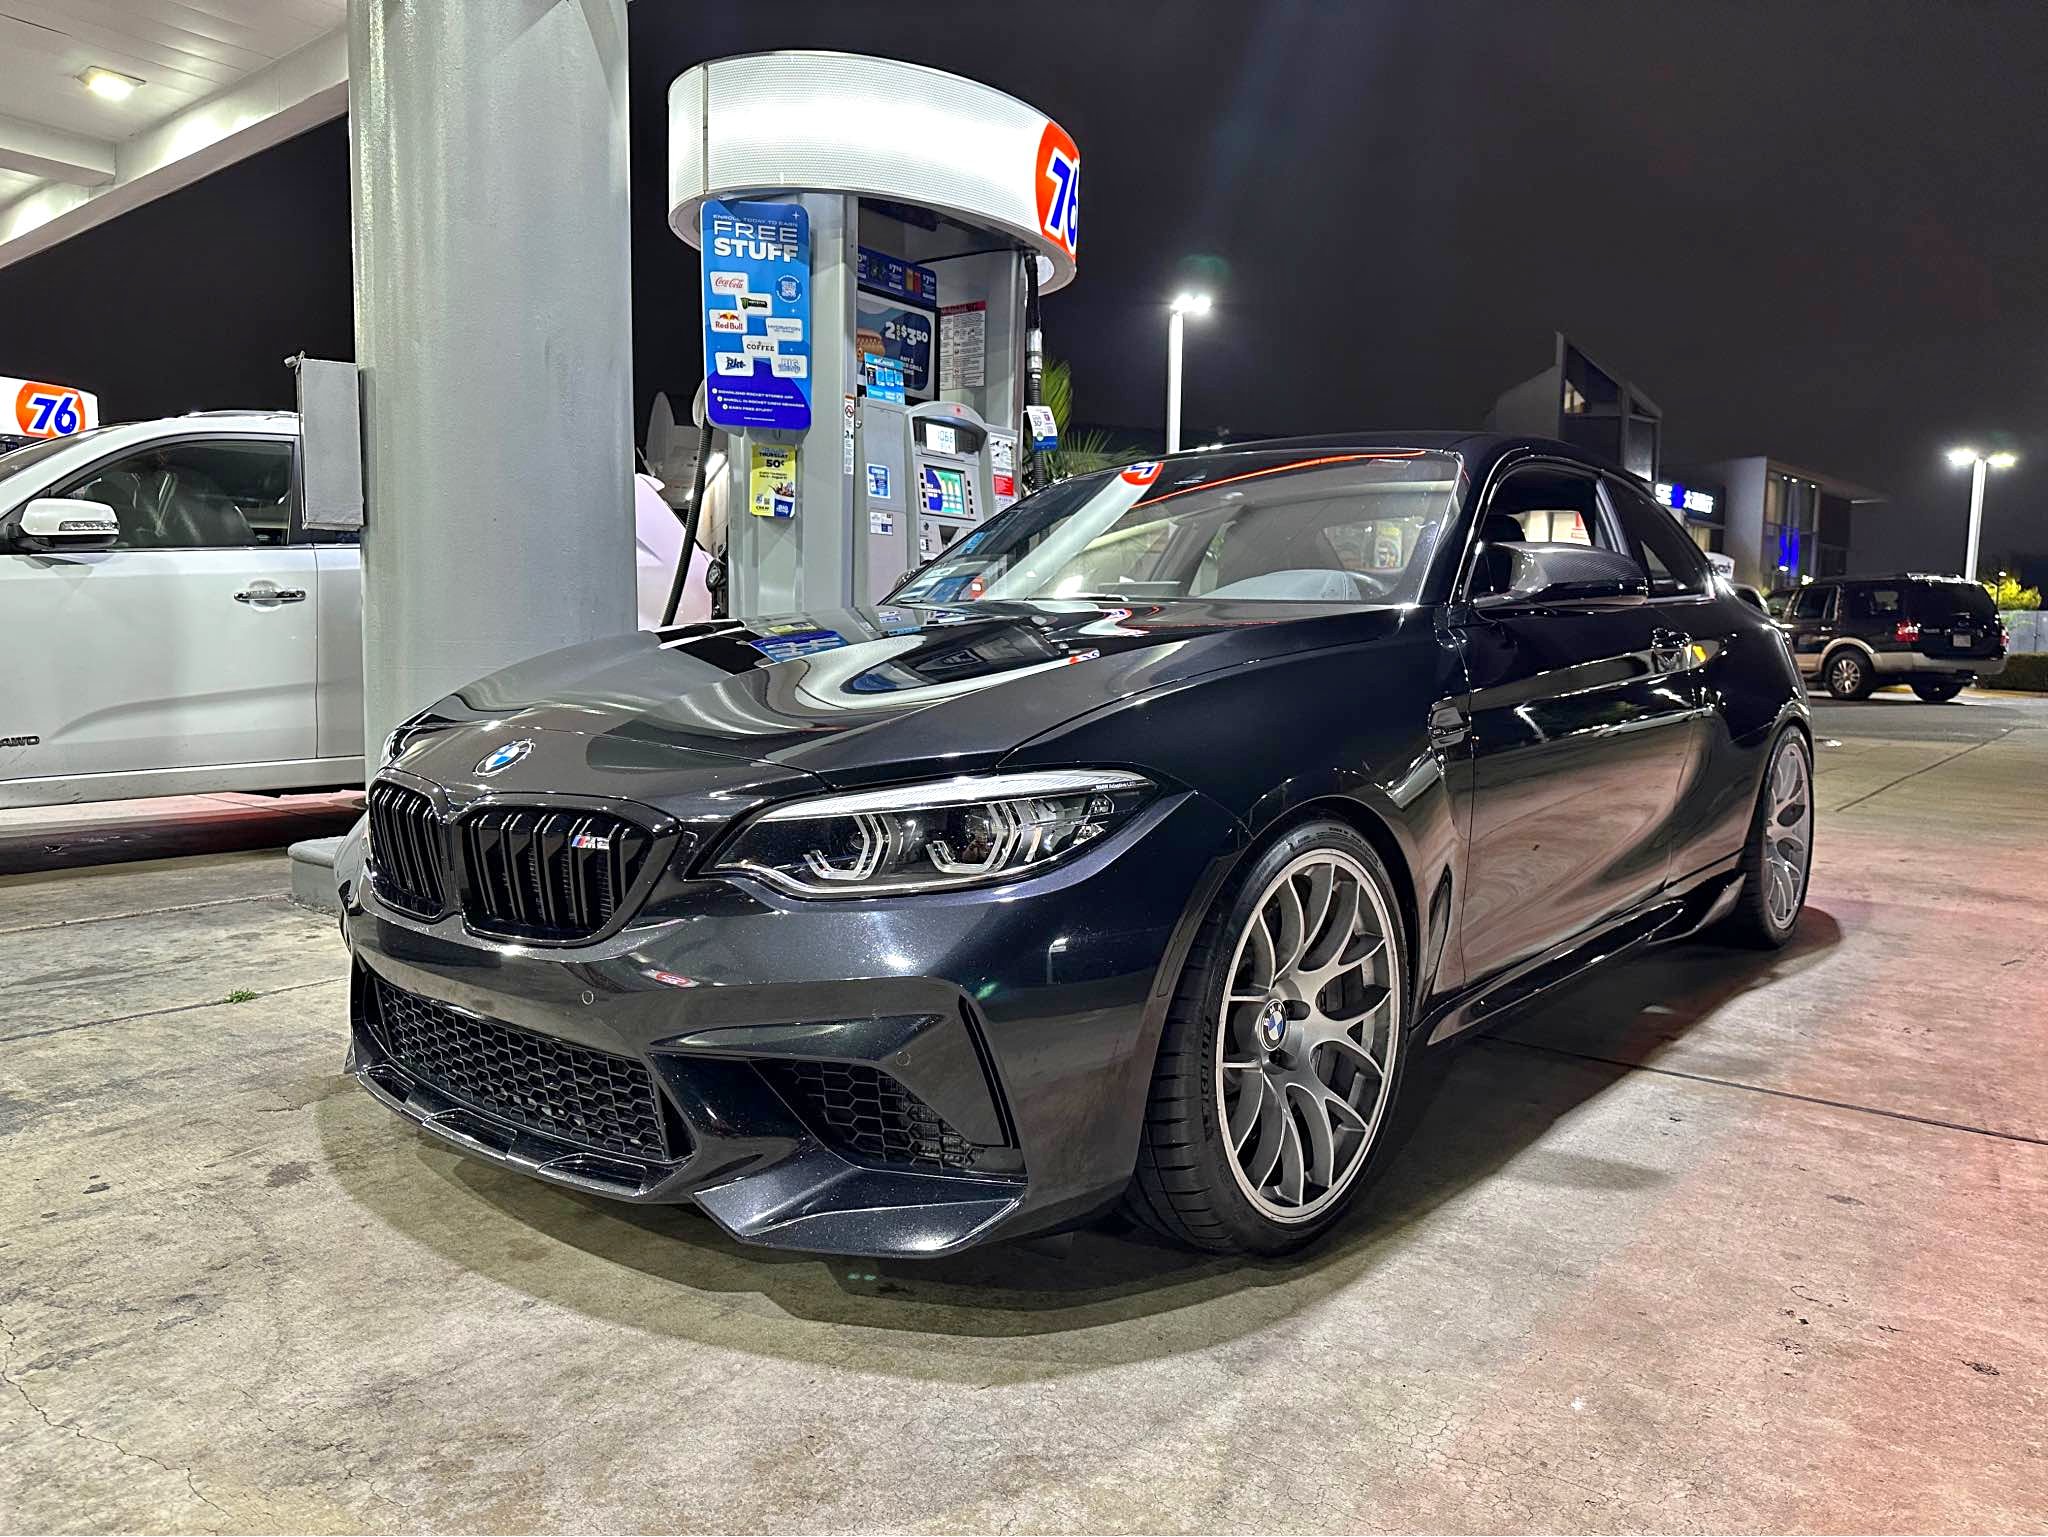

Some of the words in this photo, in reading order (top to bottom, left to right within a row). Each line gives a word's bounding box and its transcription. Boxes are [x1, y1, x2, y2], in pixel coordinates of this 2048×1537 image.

[1048, 152, 1078, 251] 76
[713, 220, 798, 243] FREE
[714, 237, 798, 263] STUFF
[715, 321, 729, 330] Red
[729, 322, 744, 331] Bull
[885, 321, 896, 339] 2
[746, 343, 775, 352] COFFEE
[29, 394, 78, 435] 76
[766, 459, 785, 468] 50¢
[0, 735, 40, 747] AWD
